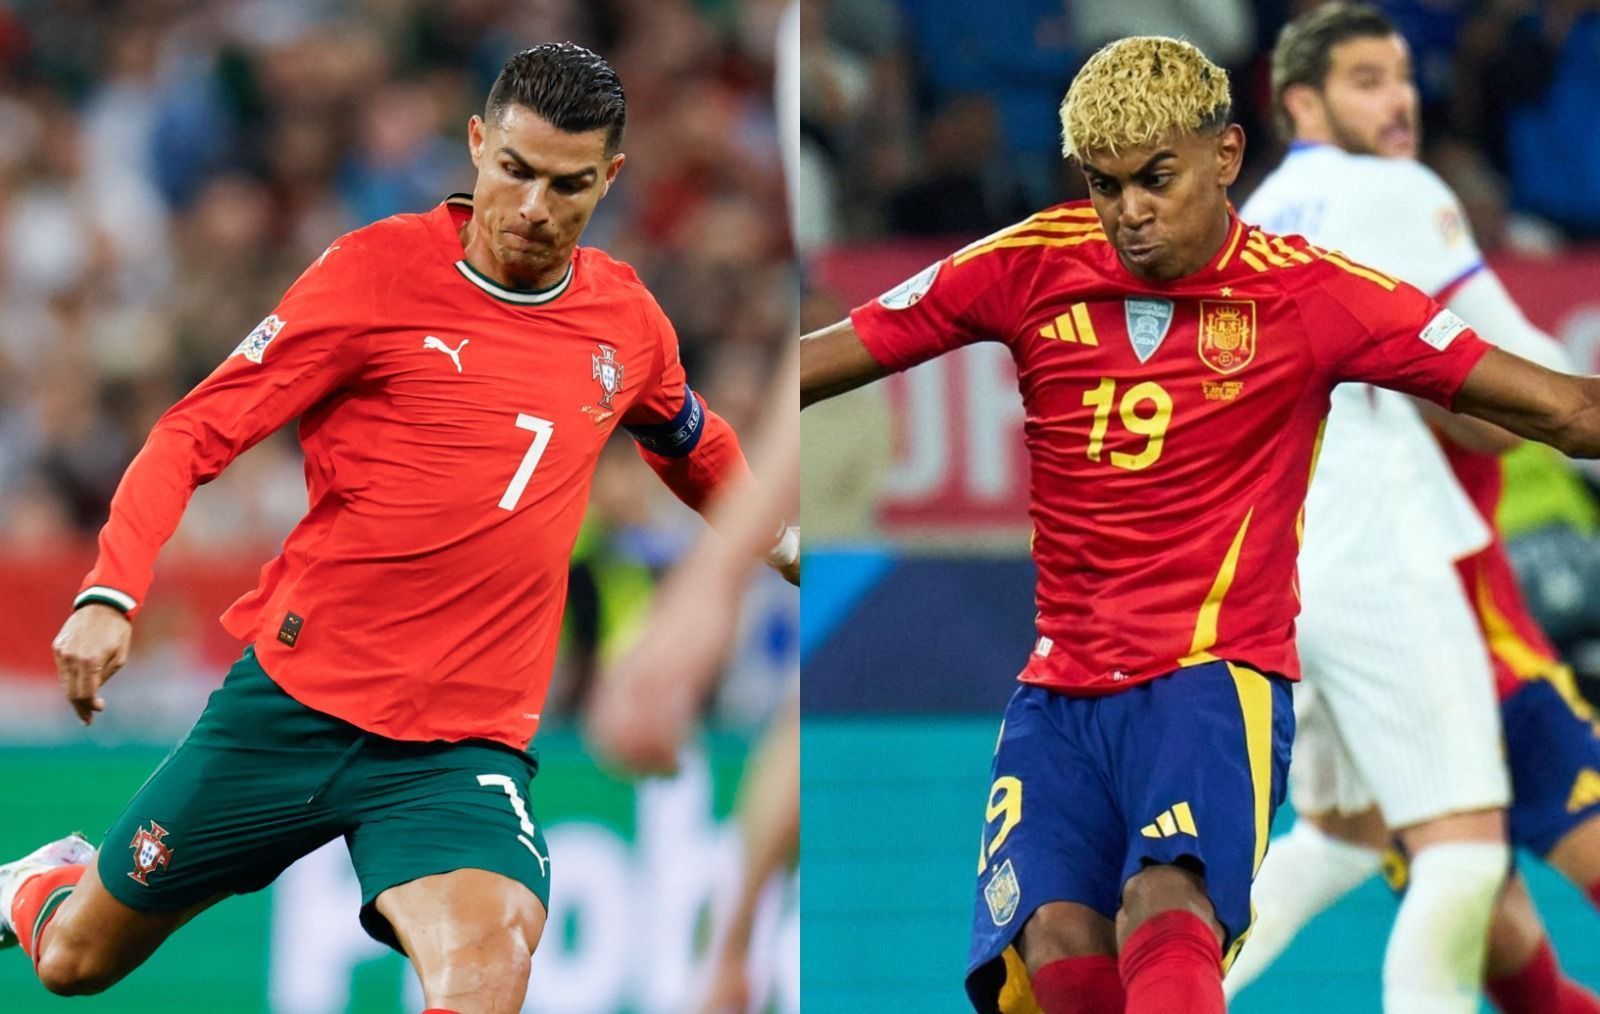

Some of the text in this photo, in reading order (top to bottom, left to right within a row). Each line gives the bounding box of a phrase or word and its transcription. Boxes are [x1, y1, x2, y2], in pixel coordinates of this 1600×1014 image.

[497, 412, 555, 511] 7
[1082, 376, 1174, 471] 19
[475, 773, 535, 836] 7
